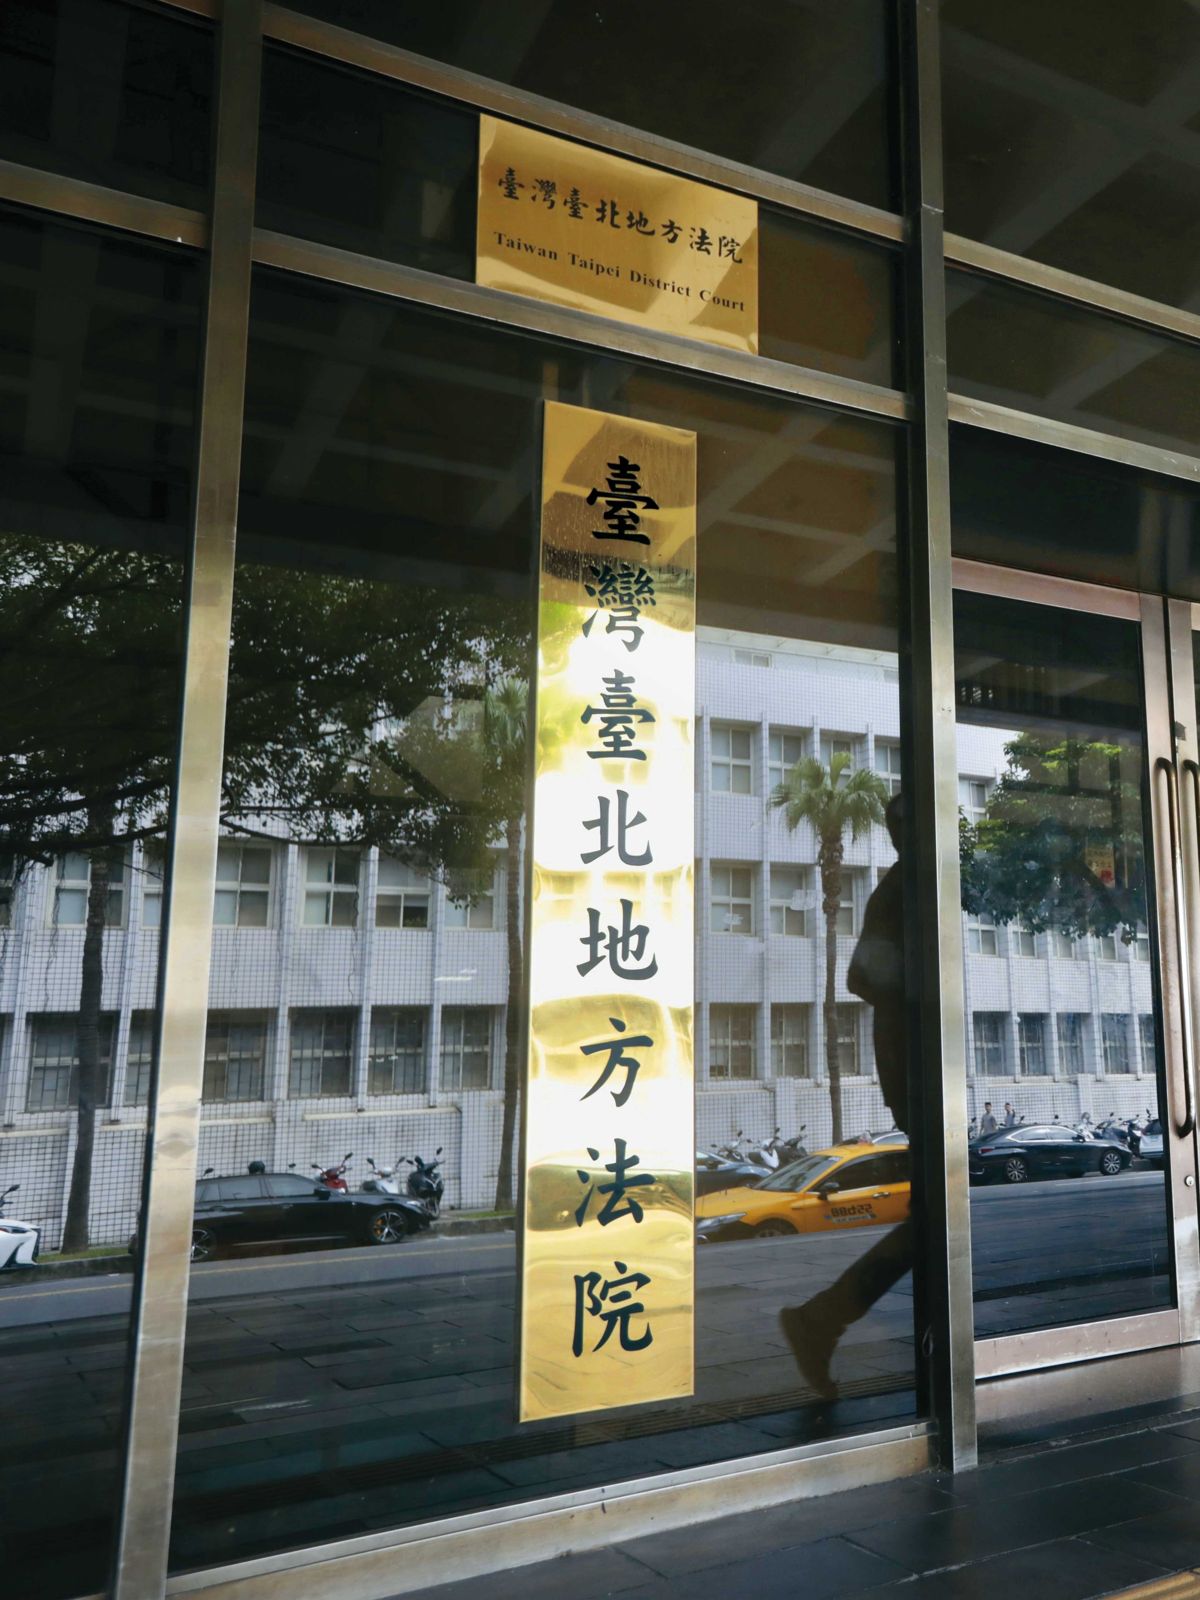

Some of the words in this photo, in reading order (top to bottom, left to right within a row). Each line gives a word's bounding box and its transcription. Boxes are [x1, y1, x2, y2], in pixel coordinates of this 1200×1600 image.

[498, 167, 743, 264] 臺灣臺北地方法院
[494, 231, 558, 261] Taiwan
[567, 252, 621, 278] Taipei
[630, 269, 691, 298] District
[700, 289, 745, 312] Court
[572, 456, 659, 1357] 臺灣臺北地方法院
